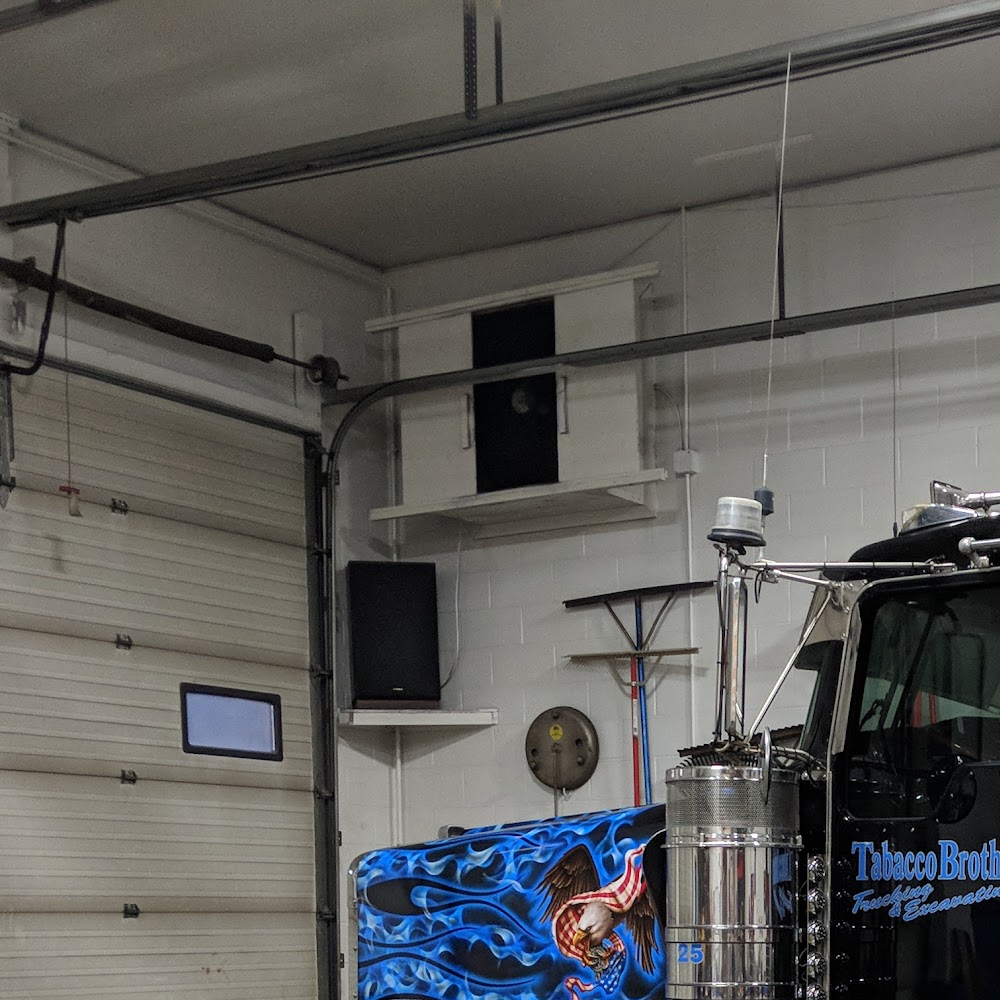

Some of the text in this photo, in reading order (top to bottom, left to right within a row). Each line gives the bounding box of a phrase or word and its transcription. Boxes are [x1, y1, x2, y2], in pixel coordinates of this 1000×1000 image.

[851, 839, 938, 882] Tabacco
[851, 883, 934, 915] Trucking
[888, 902, 901, 918] &
[677, 943, 704, 965] 25
